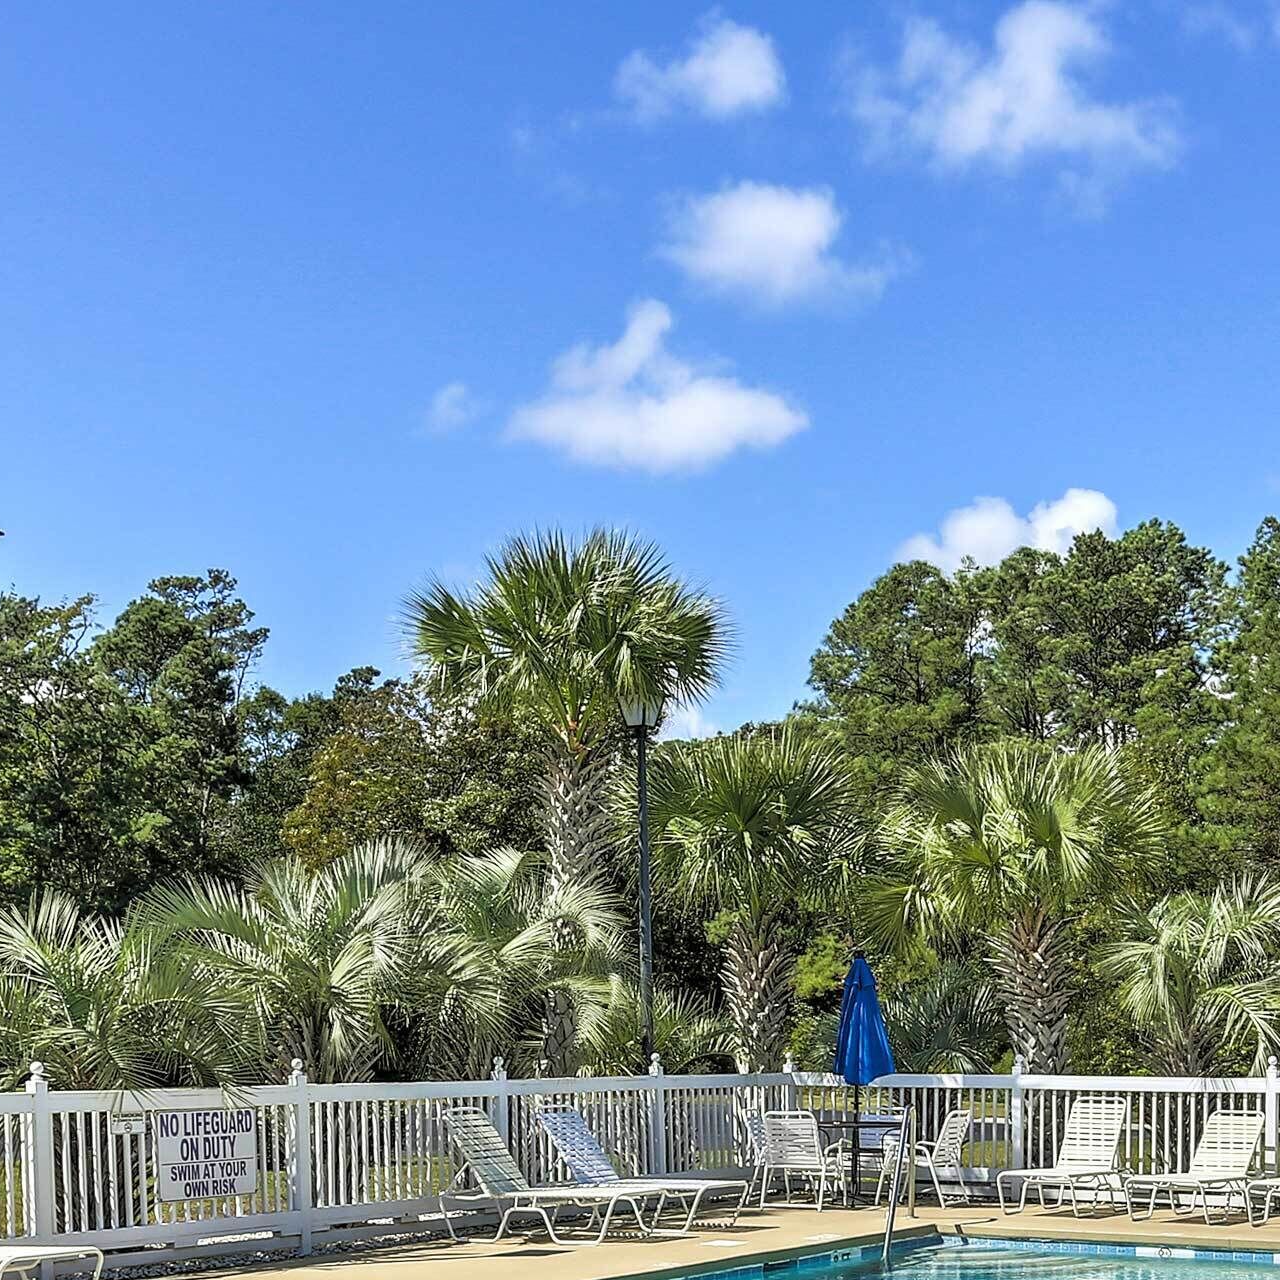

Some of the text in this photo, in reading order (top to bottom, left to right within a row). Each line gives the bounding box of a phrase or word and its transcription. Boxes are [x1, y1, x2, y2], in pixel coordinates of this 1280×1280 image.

[160, 1110, 252, 1137] NO LIFEGUARD
[180, 1135, 236, 1161] ON DUTY
[170, 1161, 247, 1182] SWIM AT YOUR
[184, 1178, 237, 1198] OWN RISK
